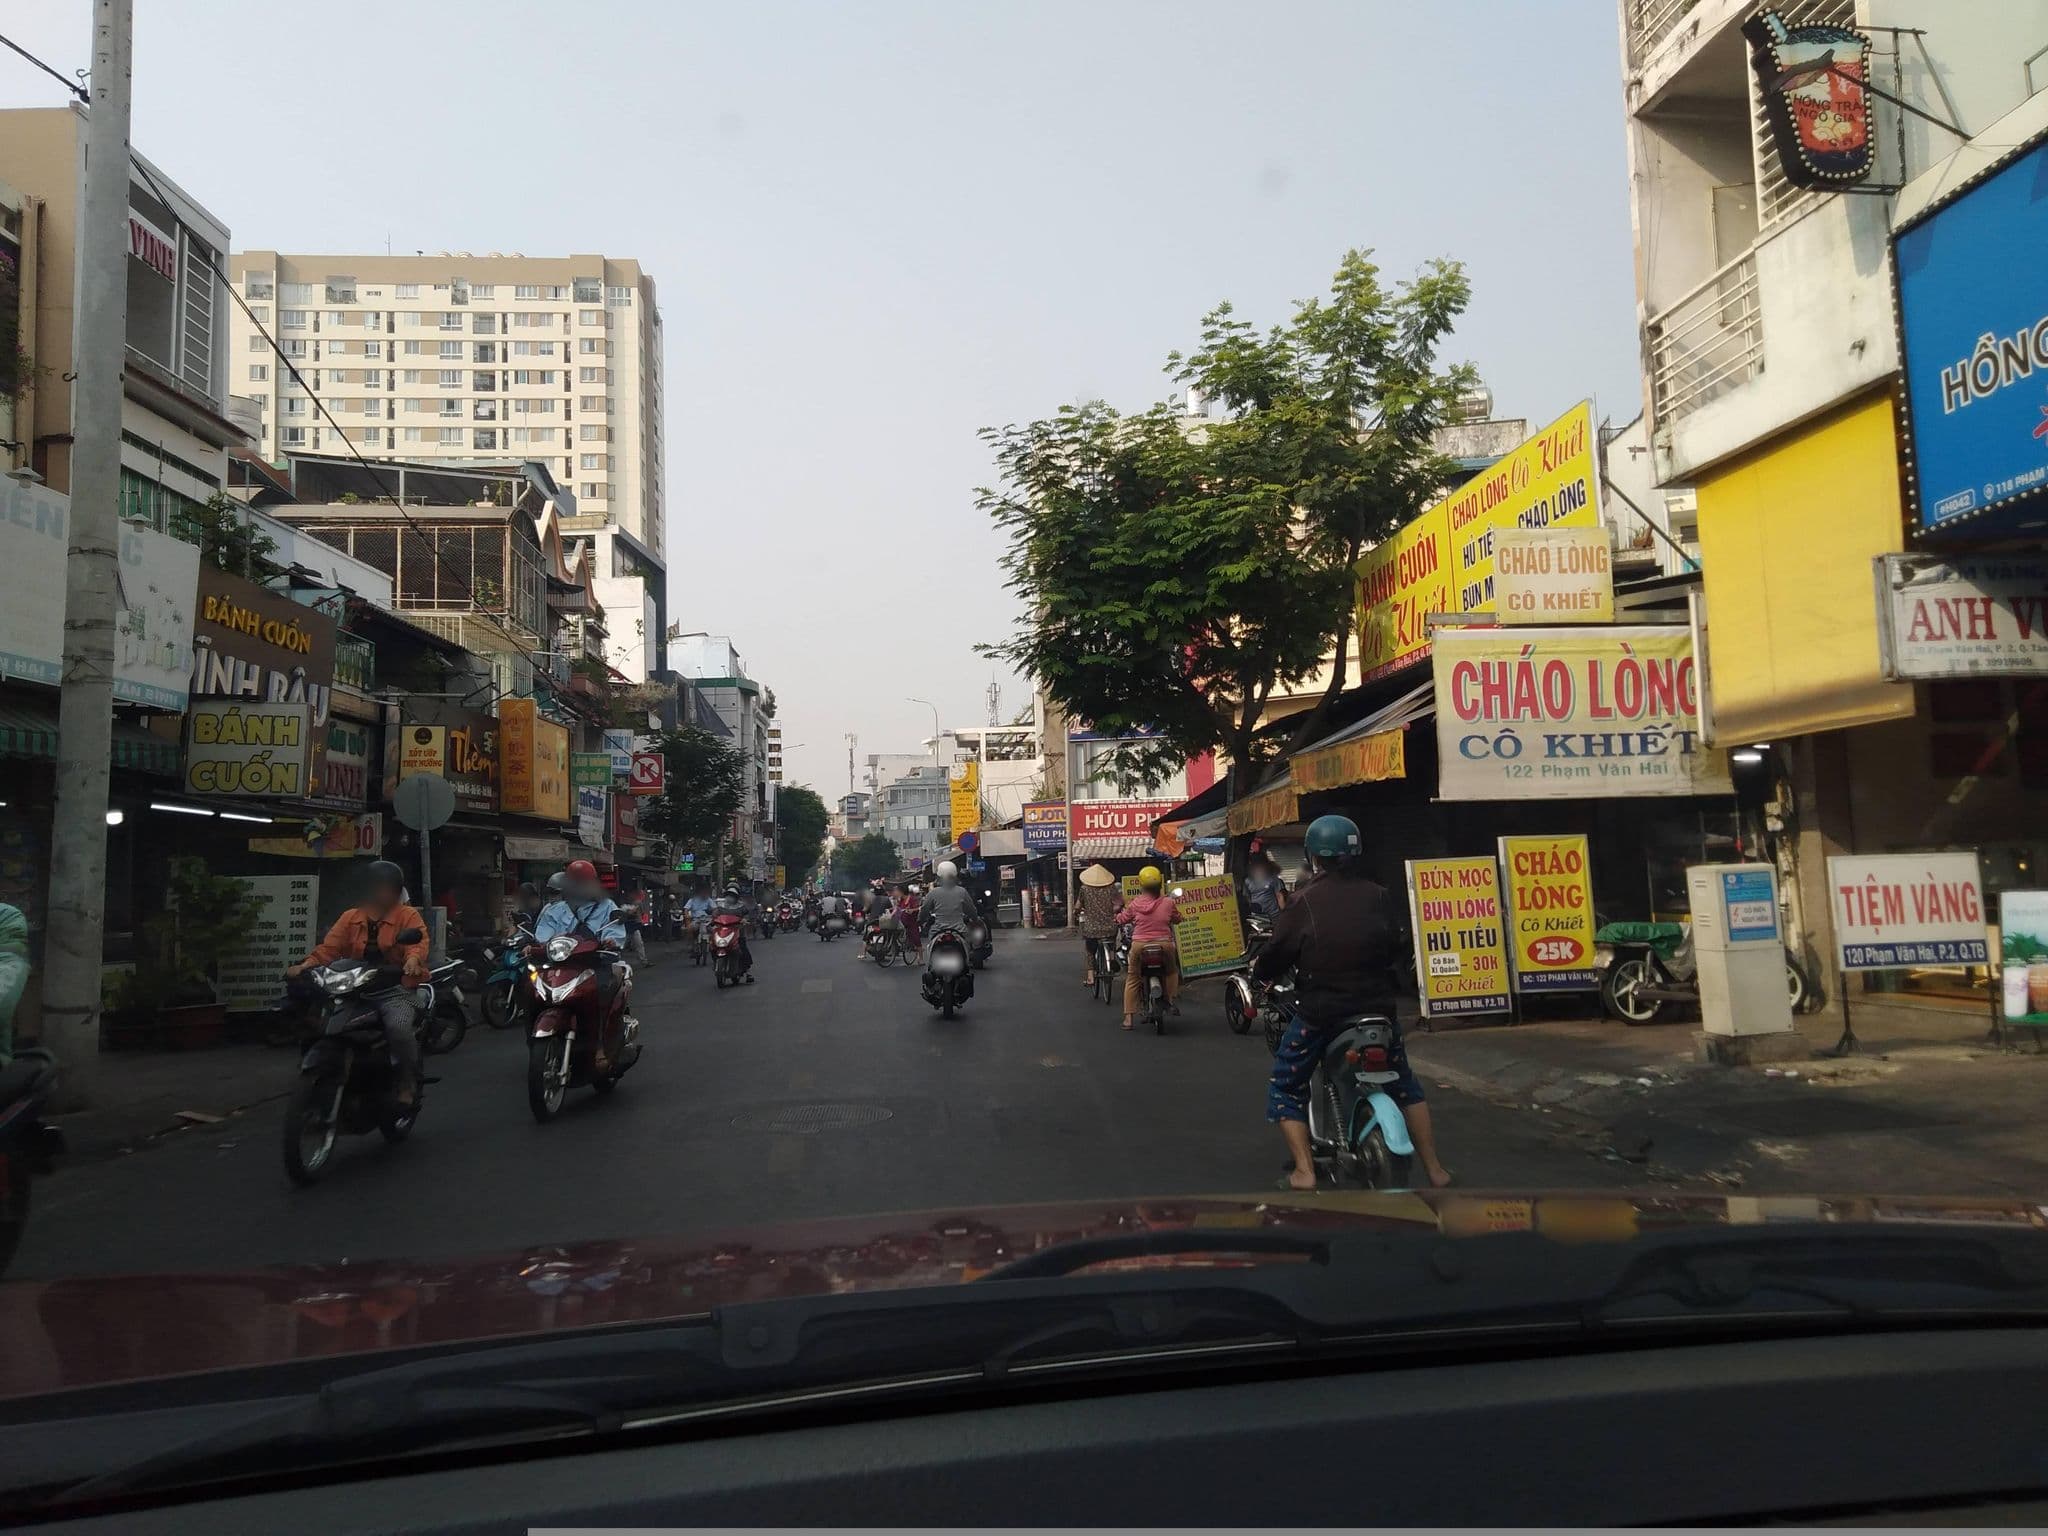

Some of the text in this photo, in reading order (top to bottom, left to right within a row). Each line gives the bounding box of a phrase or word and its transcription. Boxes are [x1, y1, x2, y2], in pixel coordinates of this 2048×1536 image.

[1452, 494, 1478, 531] CHÁO
[1480, 472, 1509, 515] LÒNG
[1553, 478, 1586, 522] LÒNG
[1478, 522, 1493, 560] TIẾ
[1361, 560, 1396, 611] BÁNH
[1398, 525, 1437, 589] CUỐN
[1499, 539, 1609, 575] CHÁO LÒNG
[1462, 577, 1483, 612] BÚN
[1507, 588, 1536, 611] CÔ
[1543, 585, 1602, 611] KHIẾT
[203, 594, 313, 655] BÁNH CUỐN
[1907, 596, 1997, 641] ANH
[1452, 641, 1697, 722] CHÁO LÒNG
[194, 707, 299, 747] BÁNH
[1459, 723, 1697, 760] CÔ KHIẾT
[190, 750, 298, 794] CUỐN
[1504, 762, 1669, 780] 122 Phạm Văn Hai
[1028, 828, 1050, 839] HỮU
[1052, 830, 1067, 838] PH
[1085, 810, 1127, 829] HỮU
[1514, 844, 1582, 876] CHÁO
[291, 881, 308, 889] 20K
[1420, 866, 1493, 892] BÚN MỌC
[290, 894, 308, 902] 25K
[290, 907, 307, 915] 25K
[1422, 894, 1496, 922] BÚN LÒNG
[1517, 880, 1584, 911] LÒNG
[1839, 872, 1905, 936] TIỆM
[1910, 871, 1980, 924] VÀNG
[1427, 922, 1497, 951] HỦ TIẾU
[1521, 914, 1585, 932] Cô Khiết
[1536, 942, 1575, 961] 25K
[1846, 948, 1863, 964] 120
[1865, 947, 1894, 966] Phạm
[1896, 944, 1916, 961] Văn
[1959, 942, 1985, 959] Q.TB
[1436, 975, 1495, 994] Cô Khiết
